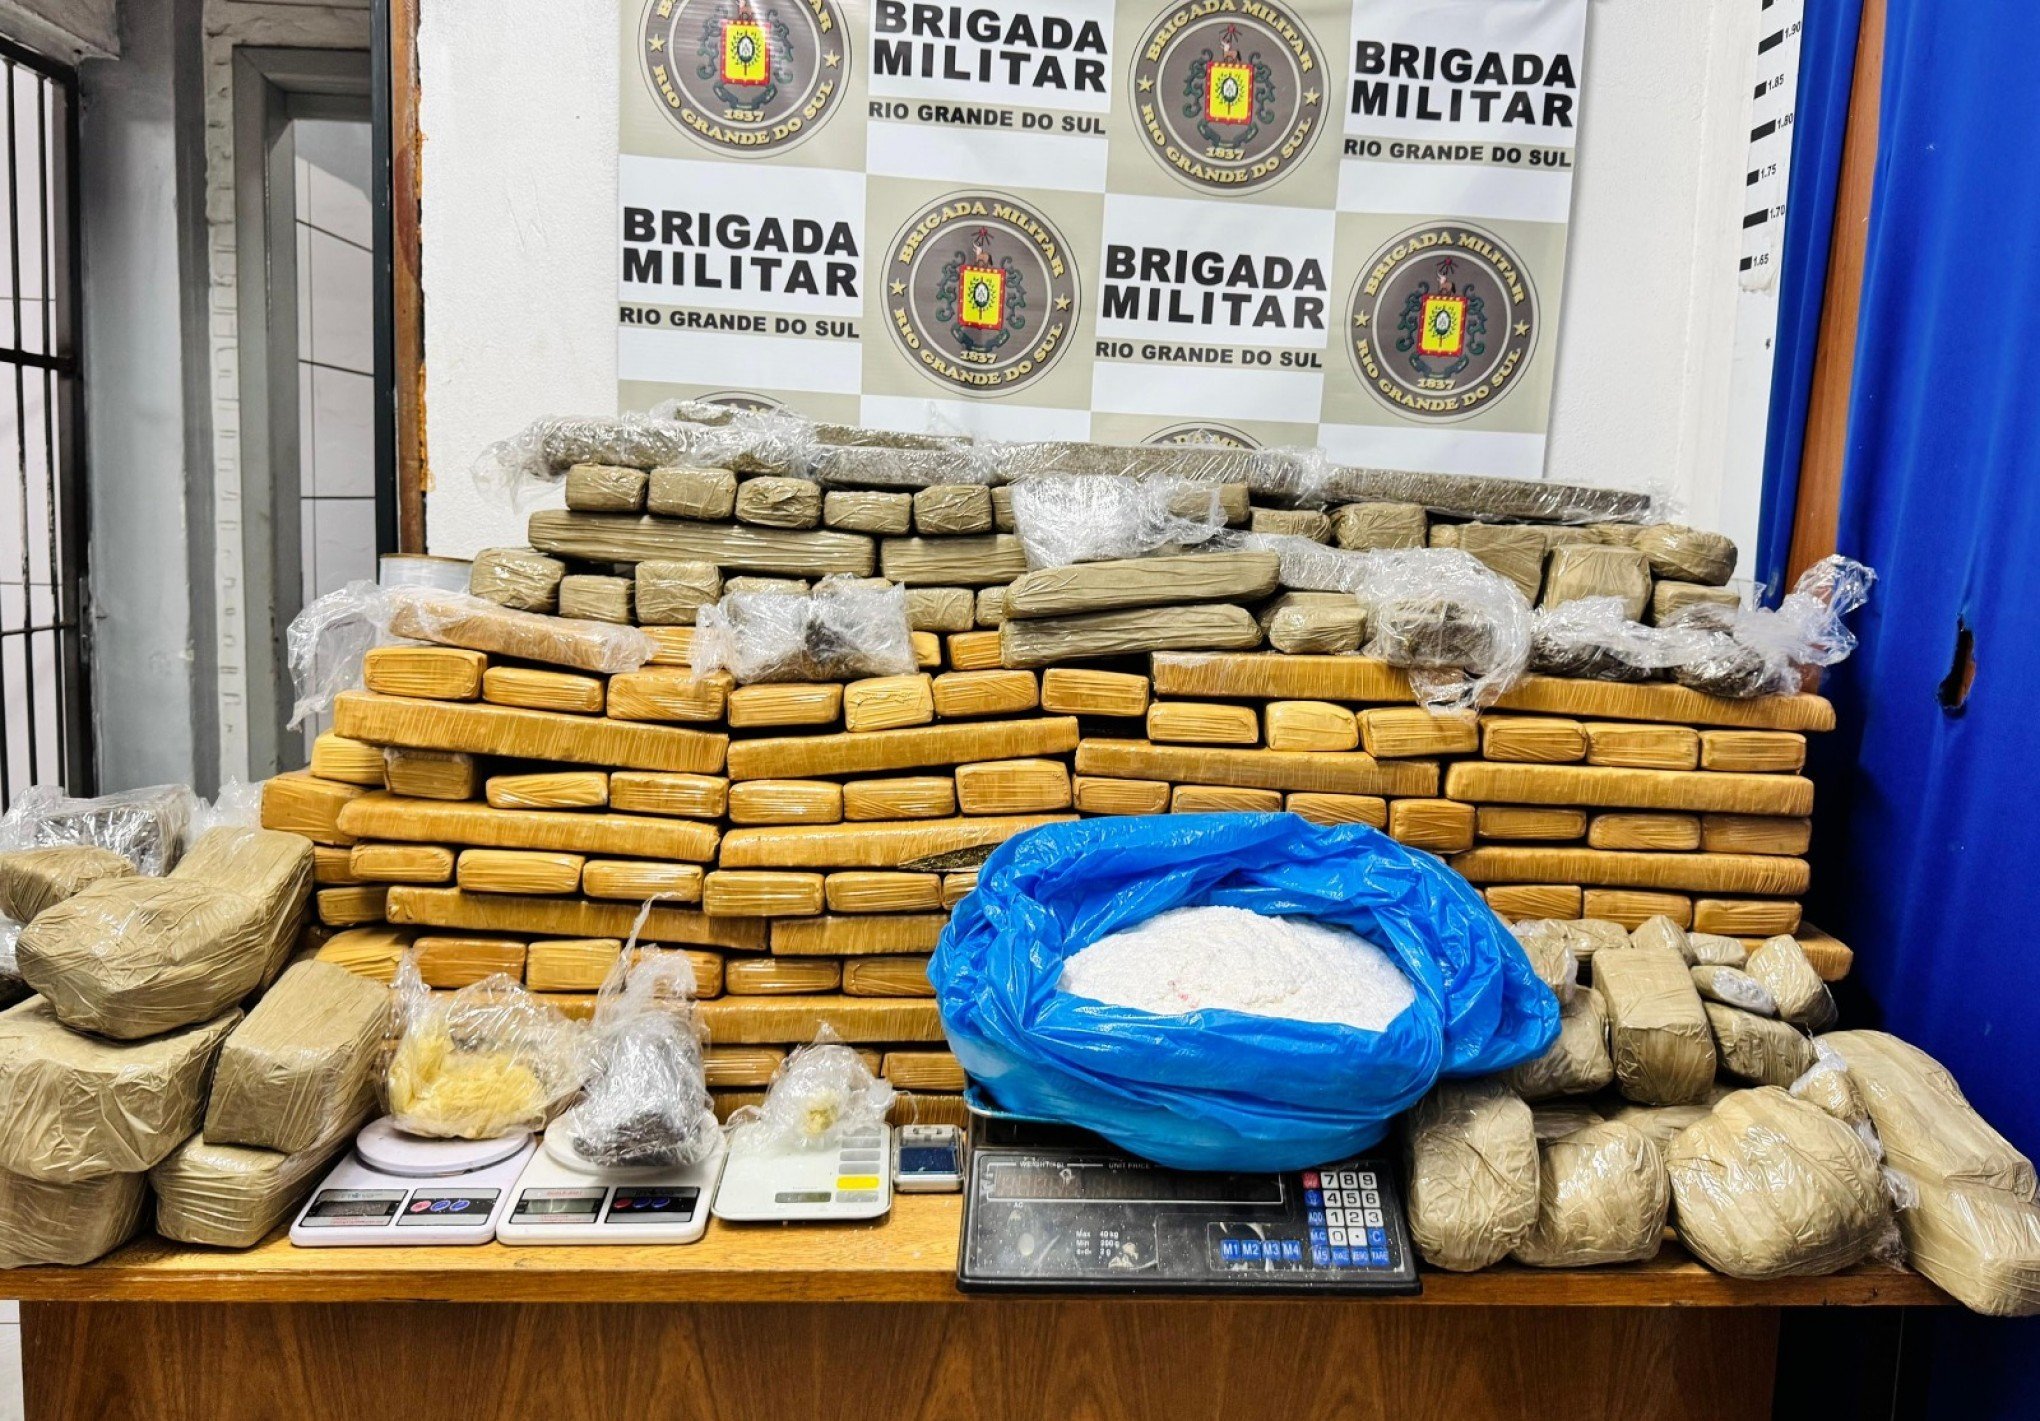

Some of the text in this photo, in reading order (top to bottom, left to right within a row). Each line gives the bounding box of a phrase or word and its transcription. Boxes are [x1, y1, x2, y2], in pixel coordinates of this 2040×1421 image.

[875, 0, 1108, 55] BRIGADA
[1145, 0, 1313, 74] BRIGADA MILITAR
[1785, 20, 1801, 39] 1.90
[874, 38, 1107, 93] MILITAR
[1355, 40, 1576, 89] BRIGADA
[1768, 73, 1784, 91] 1.85
[652, 64, 834, 145] RIO GRANDE DO SUL
[723, 109, 765, 122] 1837
[868, 101, 1106, 135] RIO GRANDE DO SUL
[1351, 80, 1573, 128] MILITAR
[1141, 103, 1312, 183] RIO GRANDE DO SUL
[1205, 147, 1245, 160] 1837
[1344, 138, 1572, 167] RIO GRANDE DO SUL
[1761, 163, 1777, 180] 1.75
[1770, 204, 1785, 219] 1.70
[624, 206, 859, 257] BRIGADA
[899, 202, 1065, 279] BRIGADA MILITAR
[623, 247, 859, 297] MILITAR
[1105, 244, 1327, 291] BRIGADA
[1364, 231, 1525, 305] BRIGADA MILITAR
[619, 306, 859, 338] RIO GRANDE DO SUL
[1102, 284, 1325, 329] MILITAR
[893, 307, 1063, 385] RIO GRANDE DO SUL
[960, 351, 998, 364] 1837
[1095, 341, 1322, 369] RIO GRANDE DO SUL
[1357, 338, 1521, 411] RIO GRANDE DO SUL
[1417, 378, 1456, 390] 1837
[1324, 1175, 1335, 1186] 7
[1343, 1175, 1354, 1186] 8
[1362, 1175, 1373, 1185] 9
[1326, 1193, 1337, 1203] 4
[1347, 1193, 1357, 1203] 5
[1366, 1193, 1377, 1203] 6
[1331, 1212, 1339, 1222] 1
[1350, 1212, 1359, 1222] 2
[1369, 1212, 1379, 1222] 3
[1223, 1244, 1299, 1255] M1 M2 M3 M4
[1332, 1231, 1343, 1241] 0
[1372, 1231, 1381, 1242] C
[1314, 1250, 1328, 1261] M5
